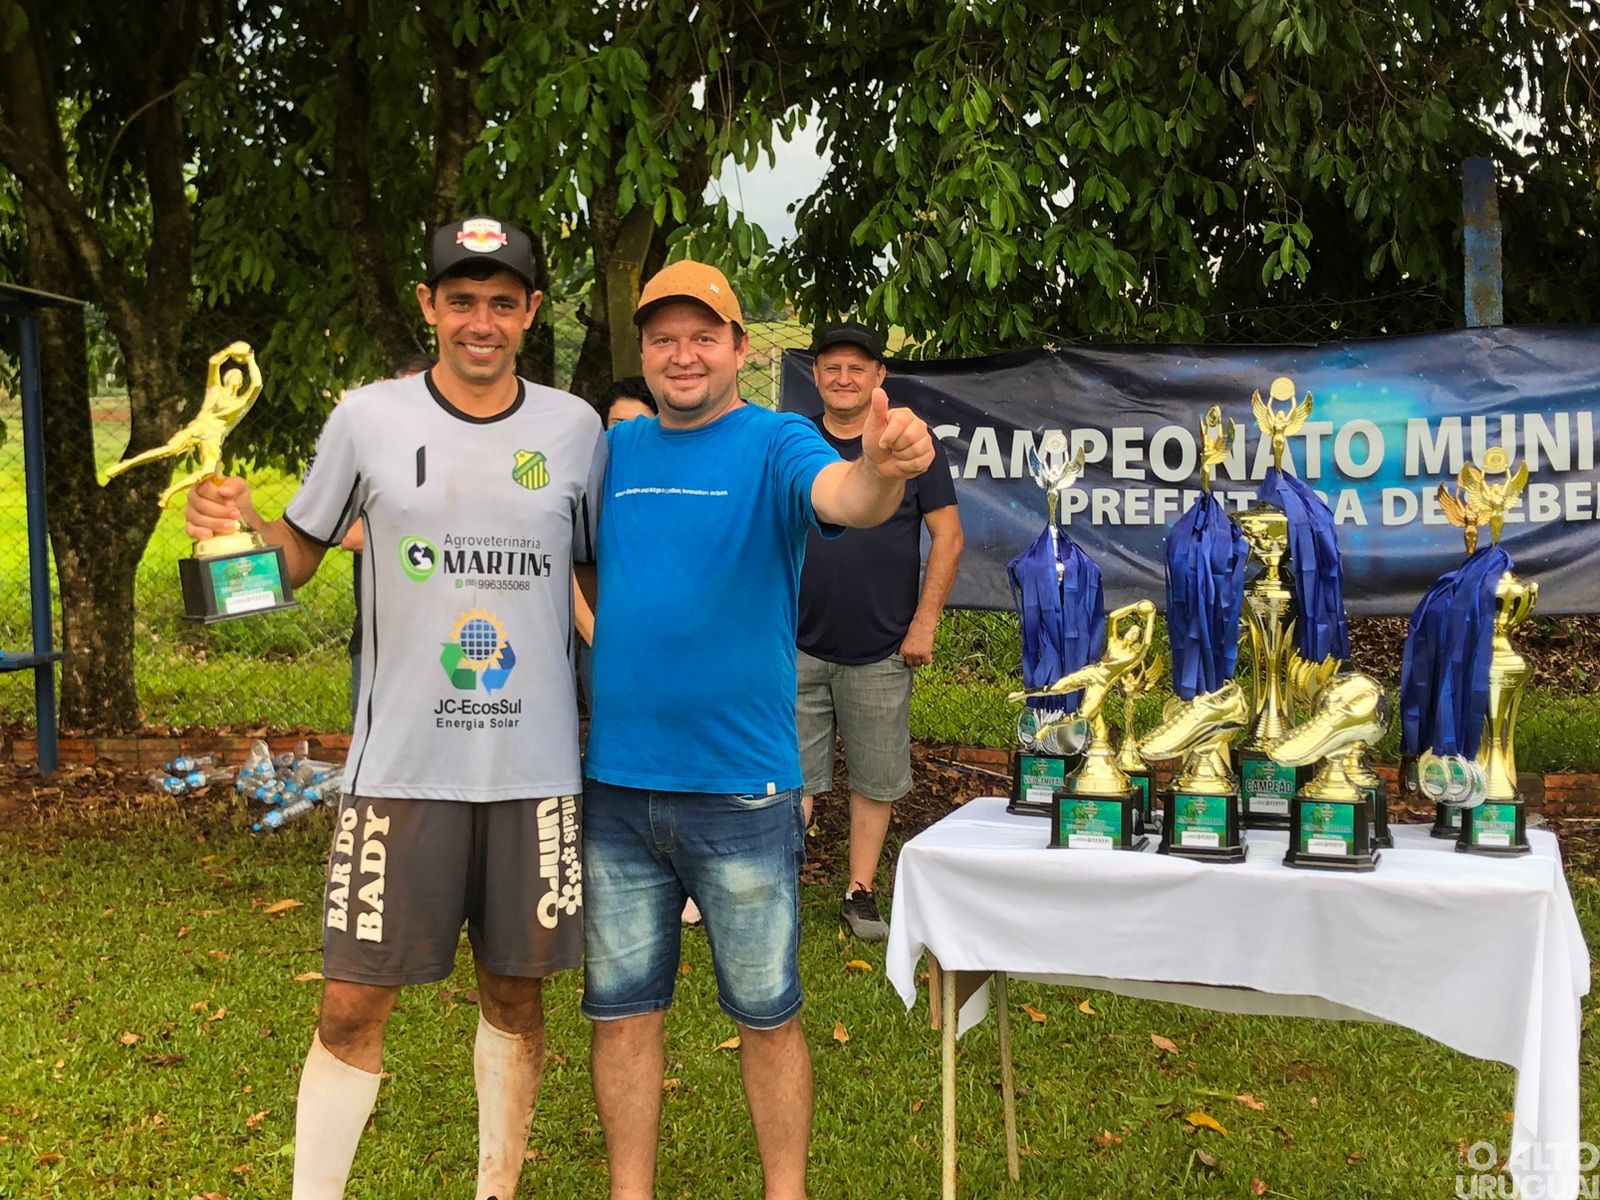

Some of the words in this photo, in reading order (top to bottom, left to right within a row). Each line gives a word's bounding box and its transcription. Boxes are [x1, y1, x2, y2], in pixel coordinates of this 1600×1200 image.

[1404, 411, 1594, 476] MUNI
[1060, 488, 1368, 526] PREFTA
[1382, 486, 1449, 525] DE
[443, 550, 552, 578] MARTINS
[478, 579, 531, 591] 996355068
[434, 698, 522, 715] JC-EcosSul
[436, 717, 485, 731] Energia
[489, 717, 519, 728] Solar
[335, 806, 359, 858] DO
[561, 796, 580, 844] mais
[355, 804, 391, 943] BADY
[327, 861, 353, 932] BAR
